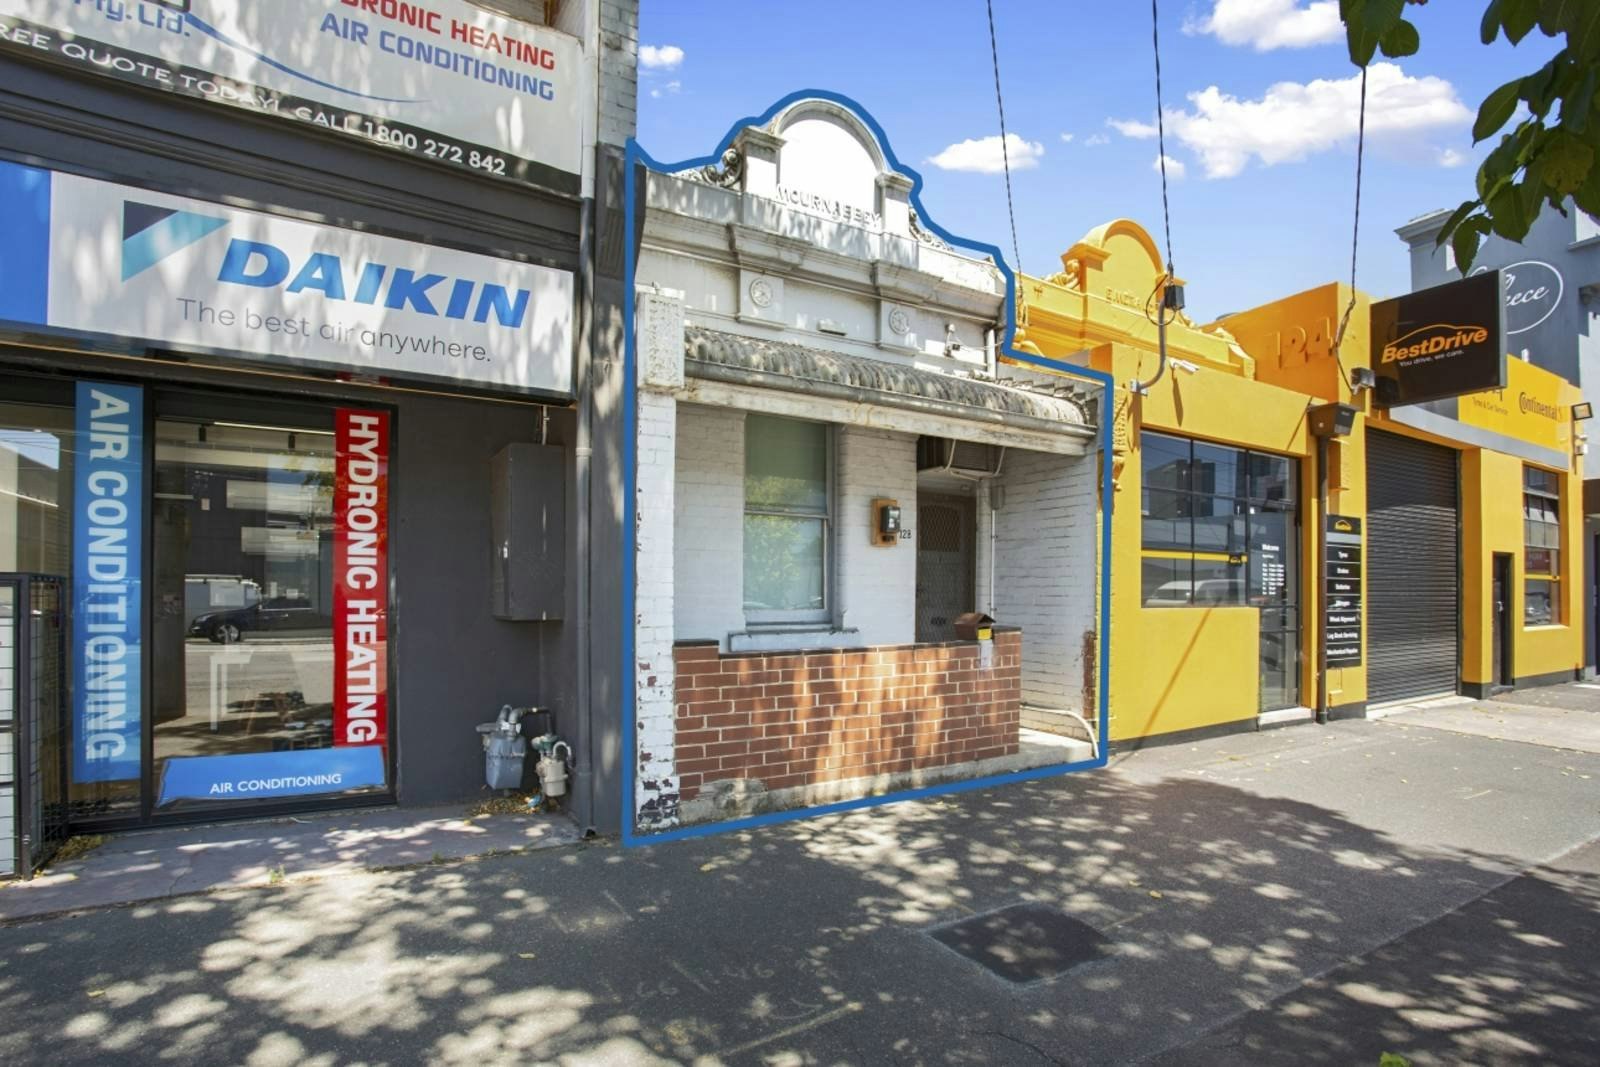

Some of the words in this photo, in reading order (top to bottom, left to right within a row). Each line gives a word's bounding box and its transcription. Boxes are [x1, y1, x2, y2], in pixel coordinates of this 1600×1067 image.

[320, 12, 369, 45] AIR
[379, 30, 555, 101] CONDITIONING
[450, 18, 556, 71] HEATING
[61, 43, 171, 83] QUOTE
[295, 106, 358, 132] CALL
[363, 121, 418, 151] 1800
[423, 138, 463, 164] 272
[468, 150, 506, 176] 842
[217, 238, 531, 328] DAIKIN
[176, 297, 236, 326] The
[244, 307, 310, 337] best
[319, 321, 355, 343] air
[360, 327, 492, 362] anywhere.
[1381, 327, 1488, 364] BestDrive
[90, 389, 130, 461] AIR
[1519, 391, 1557, 421] Continental
[346, 415, 379, 590] HYDRONIC
[86, 470, 129, 760] CONDITIONING
[347, 600, 378, 743] HEATING
[209, 782, 234, 795] AIR
[237, 773, 342, 792] CONDITIONING
